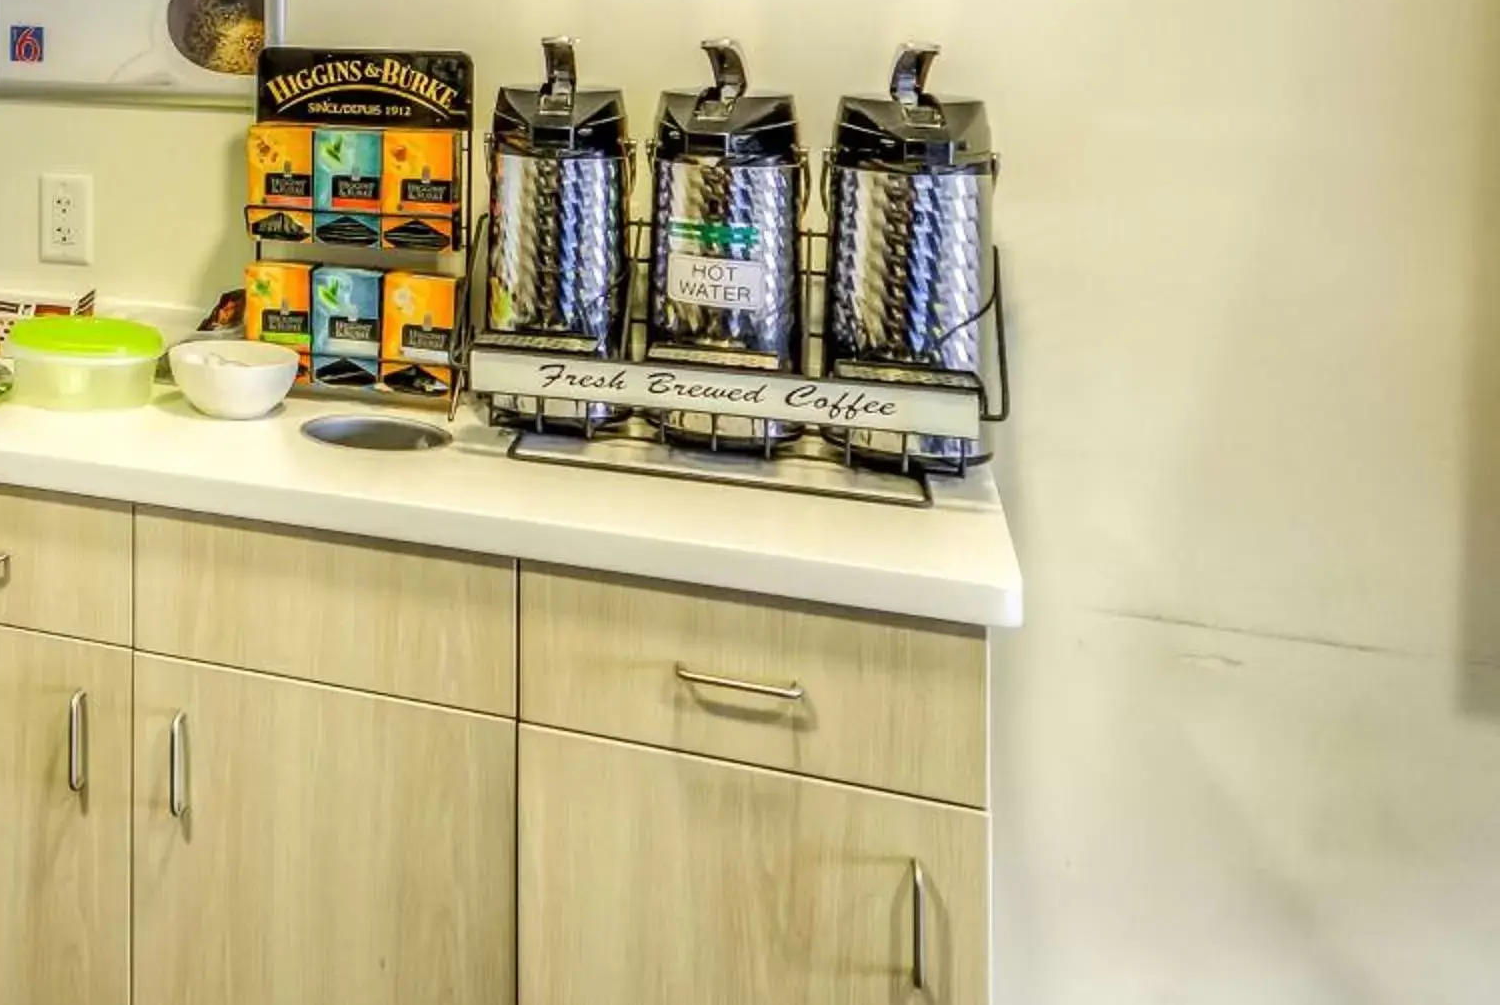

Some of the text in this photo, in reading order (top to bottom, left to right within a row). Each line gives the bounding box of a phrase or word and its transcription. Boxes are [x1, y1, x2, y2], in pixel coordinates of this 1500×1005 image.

[15, 27, 41, 63] 6
[266, 60, 362, 106] HIGGINS
[381, 58, 459, 110] BURKE
[385, 106, 412, 117] 1912
[691, 263, 738, 282] HOT
[679, 279, 751, 302] WATER
[538, 363, 897, 420] Fresh Brewed Coffee
